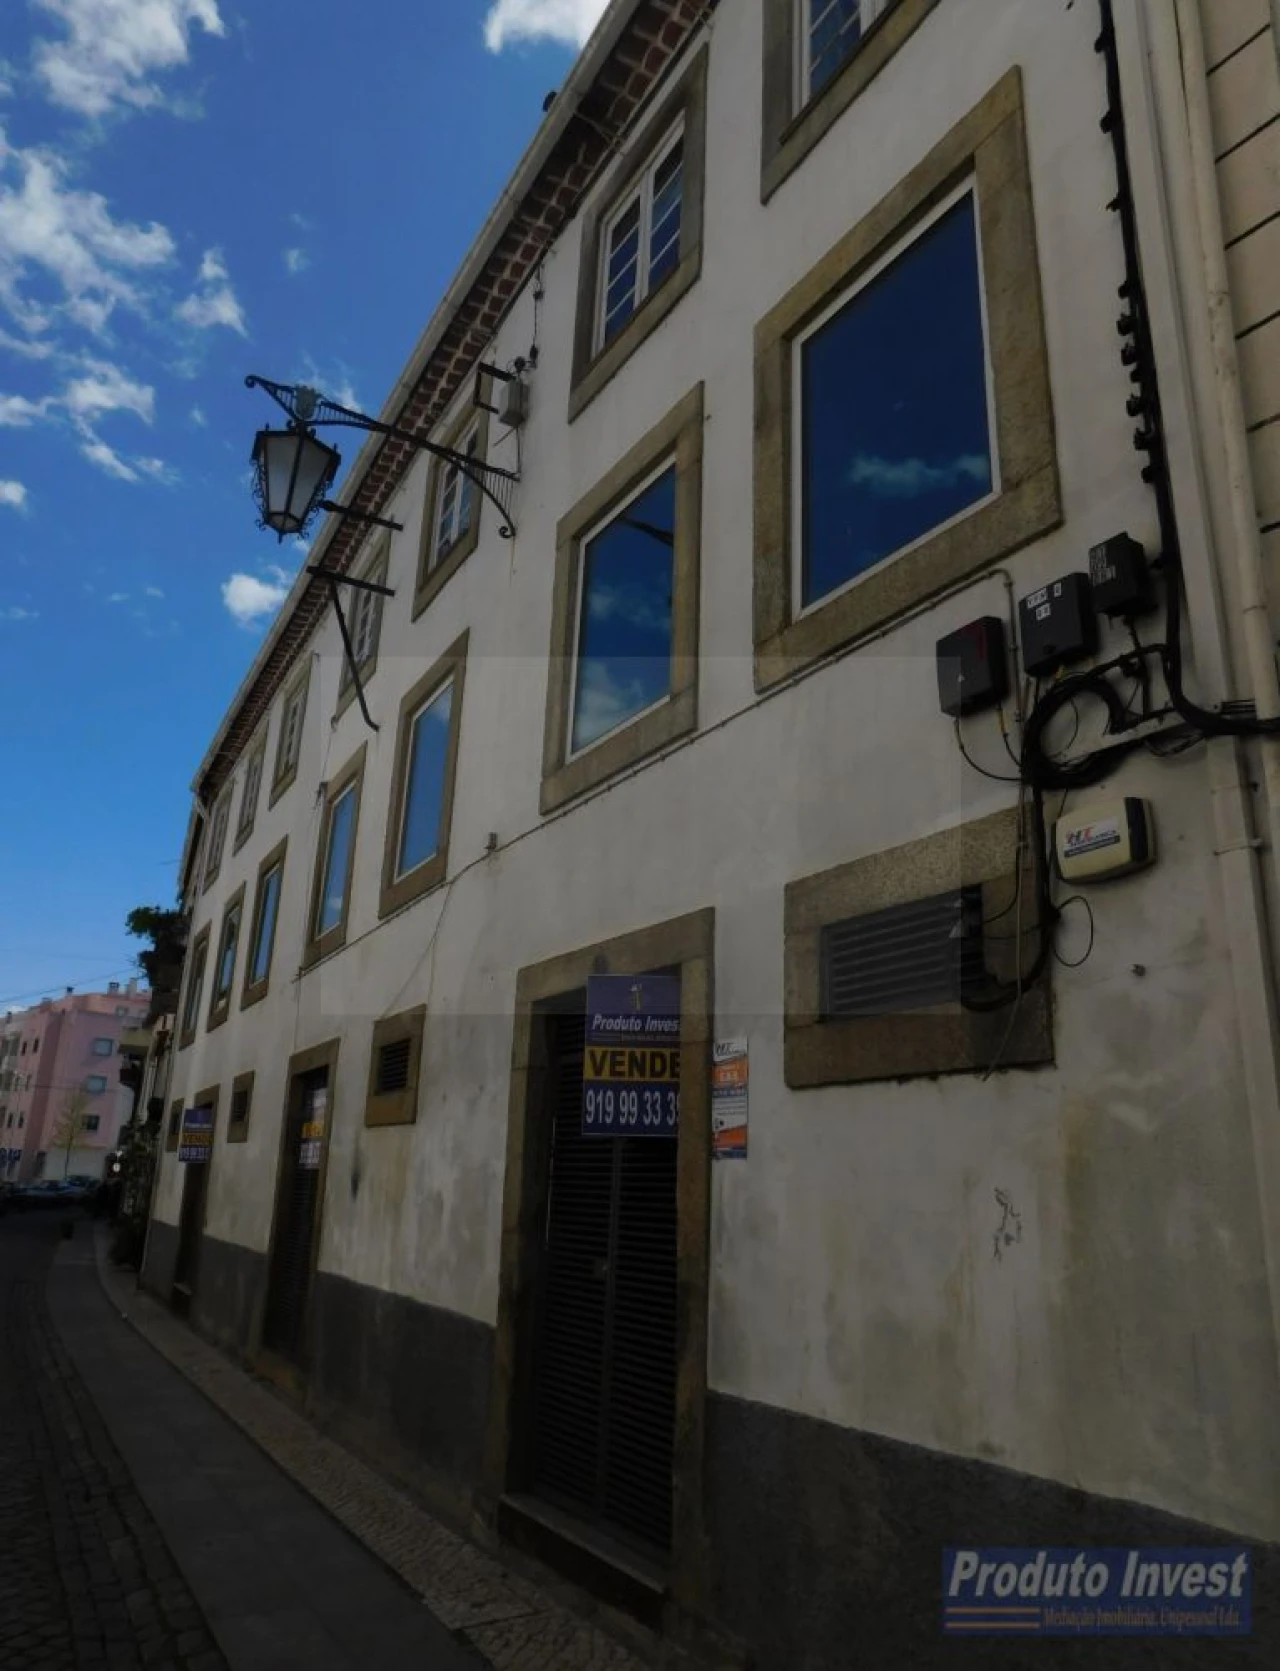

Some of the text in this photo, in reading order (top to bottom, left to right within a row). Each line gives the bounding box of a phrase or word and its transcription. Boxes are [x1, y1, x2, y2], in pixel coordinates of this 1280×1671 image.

[592, 1013, 681, 1032] Produto Inves
[586, 1088, 614, 1124] 919
[619, 1089, 638, 1125] 99
[643, 1090, 661, 1126] 33
